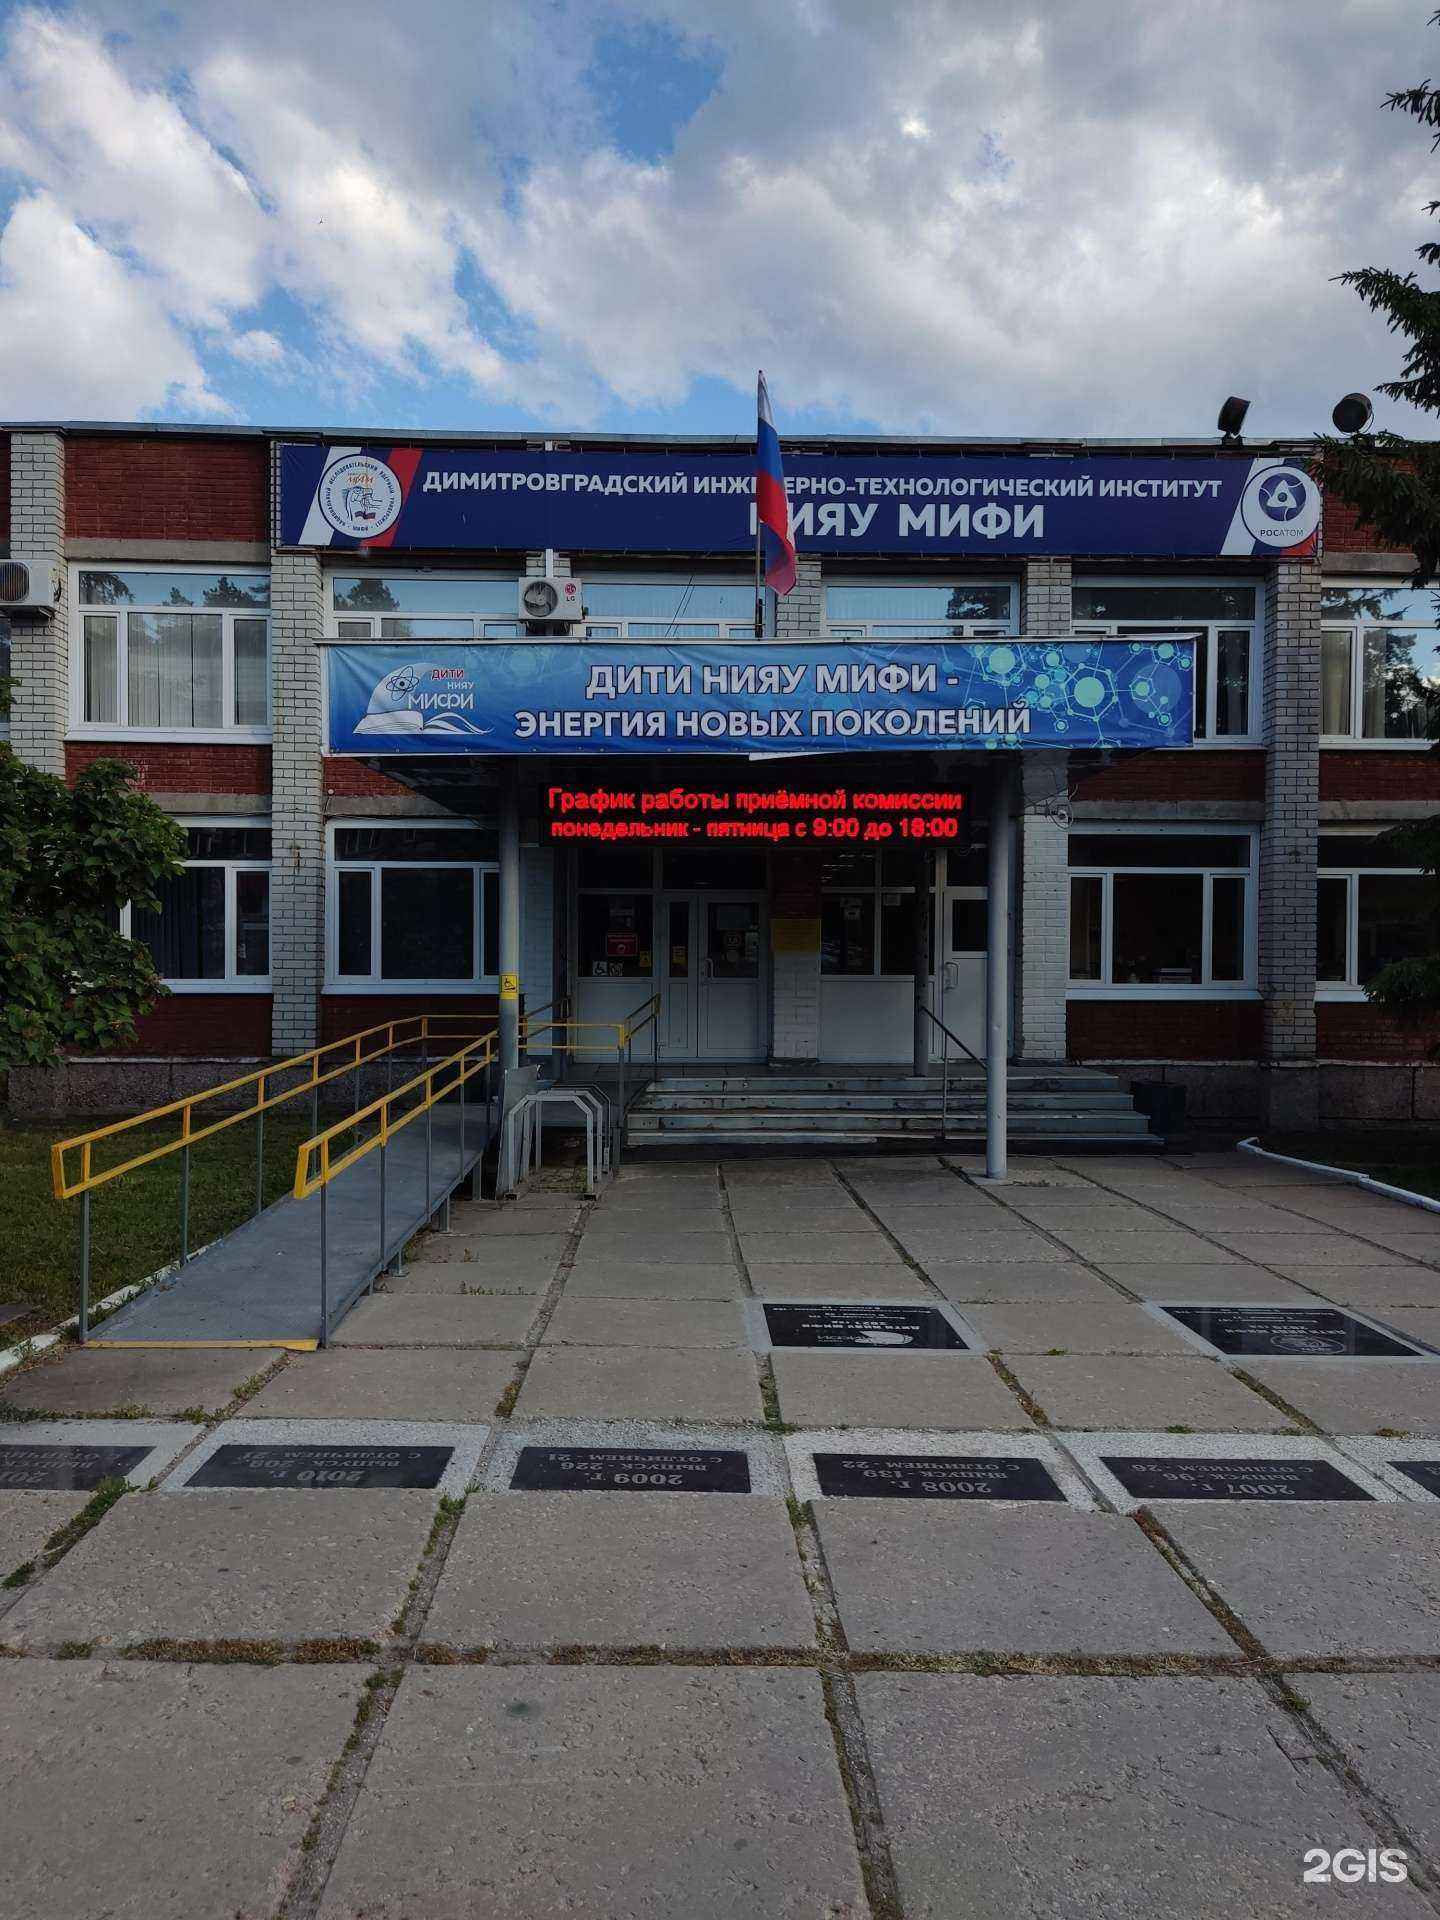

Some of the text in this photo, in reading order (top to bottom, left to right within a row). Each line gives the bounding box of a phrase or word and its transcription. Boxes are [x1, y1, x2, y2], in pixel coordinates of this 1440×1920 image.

[422, 470, 1222, 498] ДИМИТРОВГРАДСКИЙ ИНЖЕРНО-ТЕХНОЛОГИЧЕСКИЙ ИНСТИТУТ
[899, 504, 1045, 539] МИФИ
[1260, 528, 1304, 538] РОСАТОМ
[431, 668, 464, 680] ДИТИ
[586, 664, 692, 700] ДИТИ
[703, 664, 806, 694] НИЯУ
[816, 665, 937, 693] МИФИ
[447, 681, 475, 690] НИЯУ
[408, 693, 474, 709] МИФИ
[514, 701, 1031, 737] ЭНЕРГИЯ НОВЫХ ПОКОЛЕНИЙ
[549, 788, 962, 813] График работы приёмной комиссии
[551, 822, 689, 840] понедельник
[707, 822, 790, 841] пятница
[795, 822, 807, 836] с
[813, 818, 860, 837] 9:00
[864, 822, 893, 840] до
[614, 1474, 683, 1485] 2009
[922, 1482, 992, 1493] 2008
[1227, 1485, 1295, 1494] 2007
